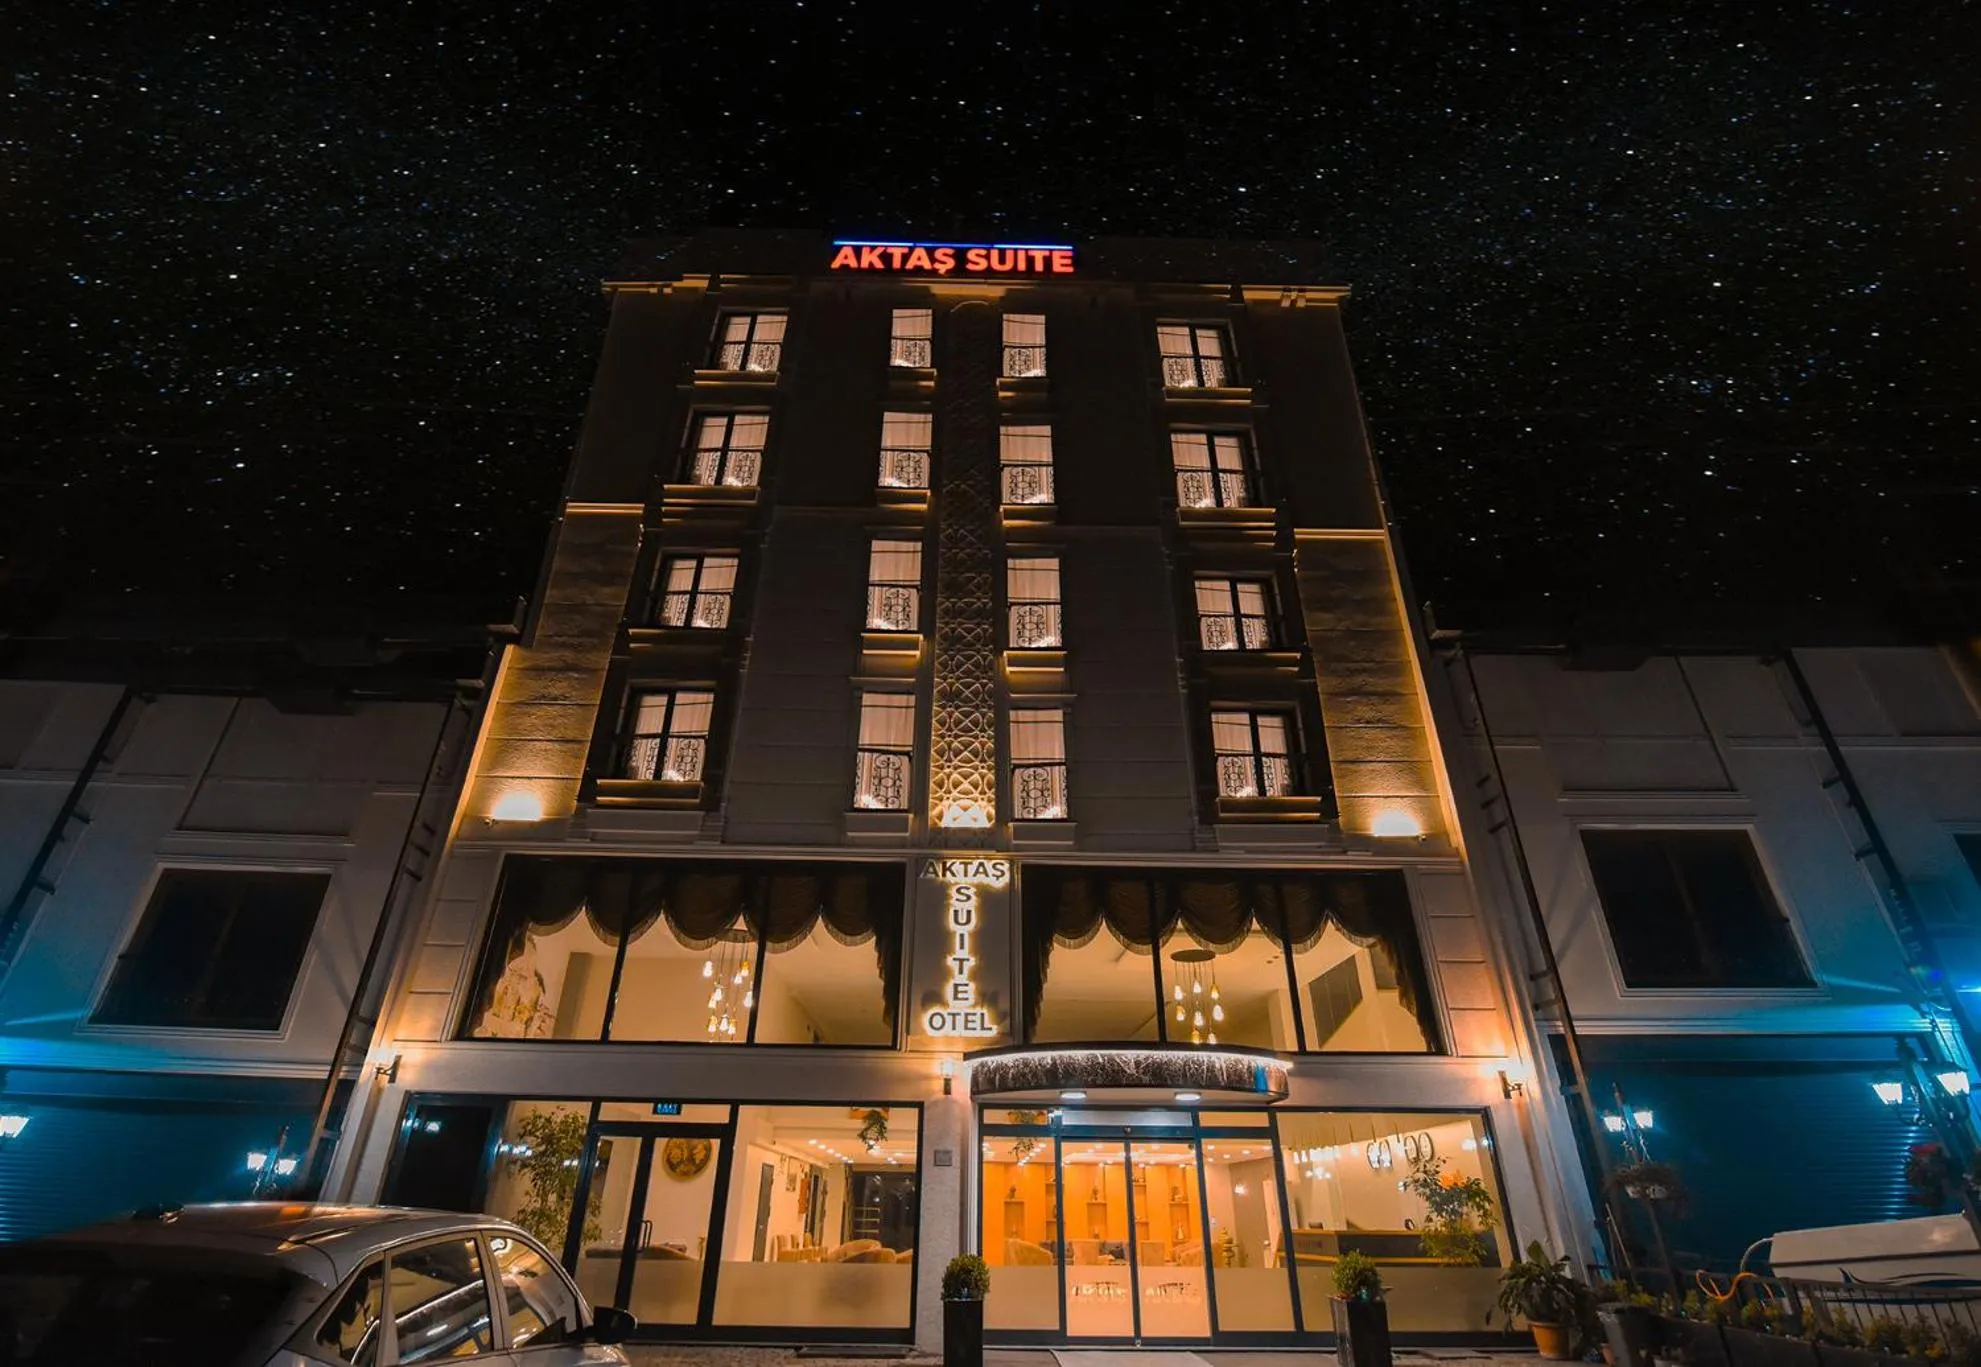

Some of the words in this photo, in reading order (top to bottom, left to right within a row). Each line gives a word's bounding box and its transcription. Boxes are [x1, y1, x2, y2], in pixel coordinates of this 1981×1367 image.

[830, 246, 956, 275] AKTAŞ
[965, 248, 1075, 274] SUITE
[921, 860, 1006, 882] AKTAŞ
[952, 885, 973, 1002] SUITE
[927, 1011, 993, 1032] OTEL
